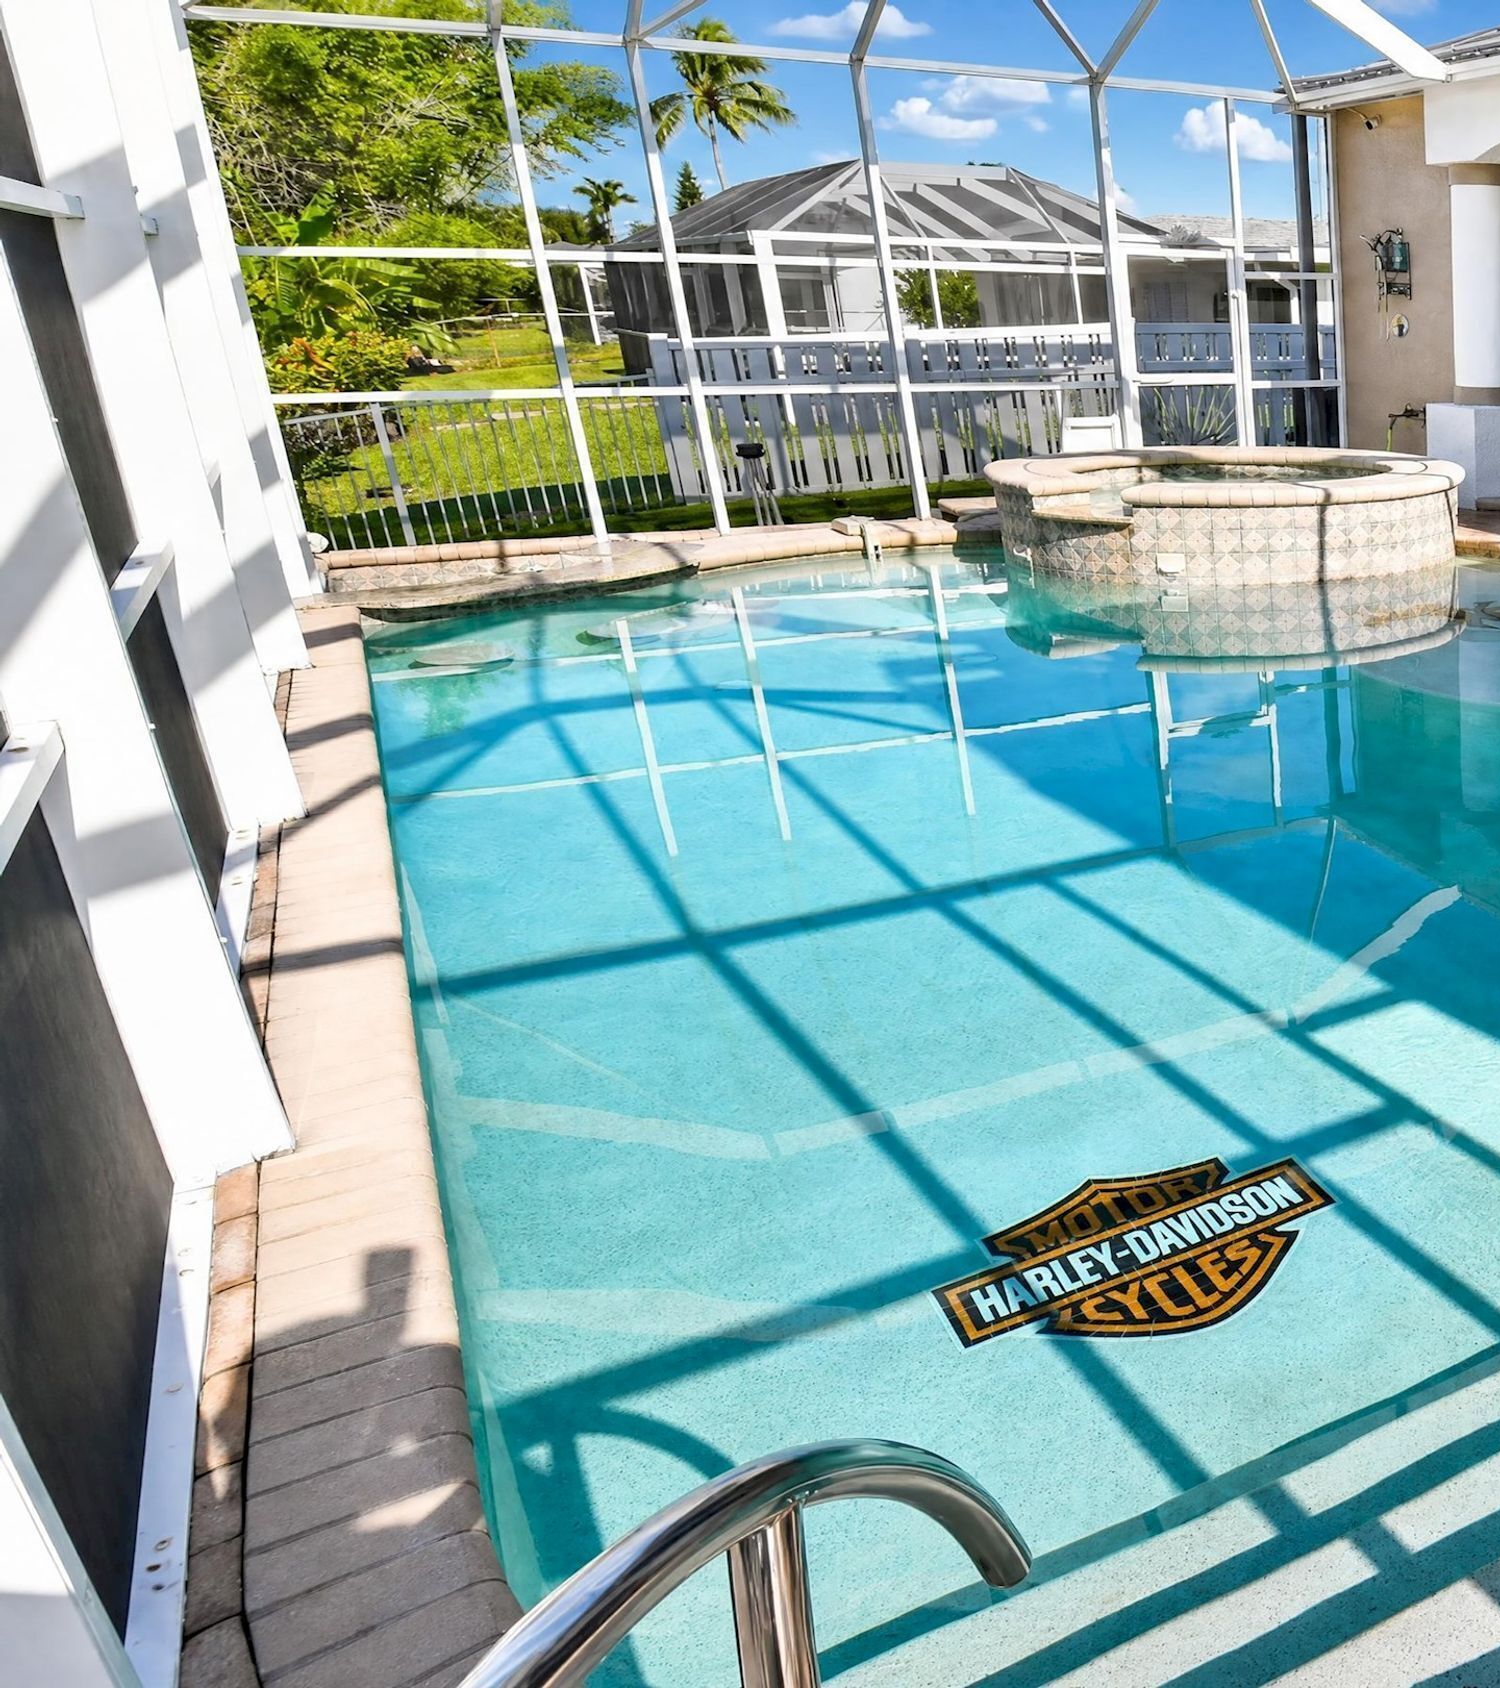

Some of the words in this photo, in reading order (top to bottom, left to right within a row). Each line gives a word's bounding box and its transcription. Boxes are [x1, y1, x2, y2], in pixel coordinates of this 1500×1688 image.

[971, 1175, 1303, 1323] HARLEY-DAVIDSON
[1032, 1177, 1204, 1251] MOTOR
[1083, 1239, 1261, 1321] CYCLES
